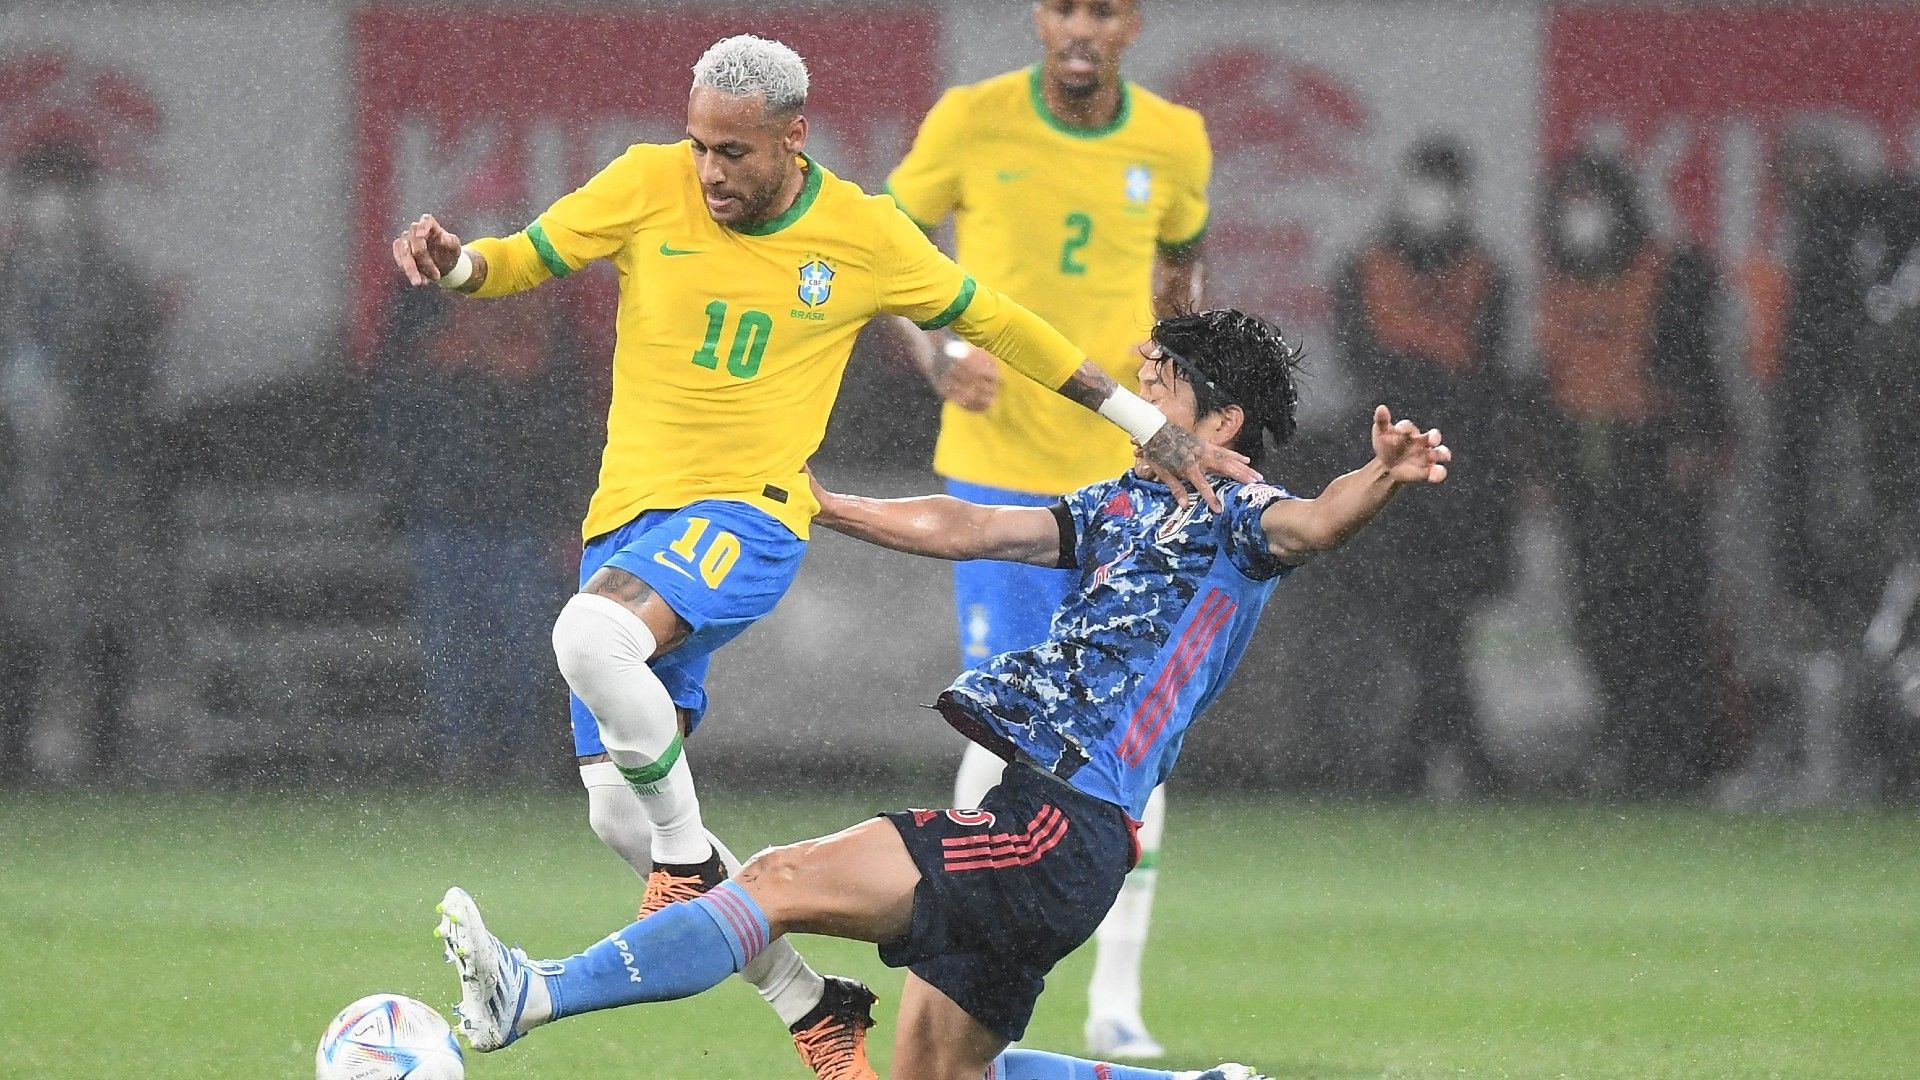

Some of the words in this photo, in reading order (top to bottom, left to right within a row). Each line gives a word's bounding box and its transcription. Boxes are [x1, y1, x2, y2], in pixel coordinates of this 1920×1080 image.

[1061, 212, 1092, 275] 2
[791, 309, 825, 320] BRASIL
[808, 279, 823, 287] CBF
[692, 300, 773, 379] 10
[670, 516, 741, 589] 10
